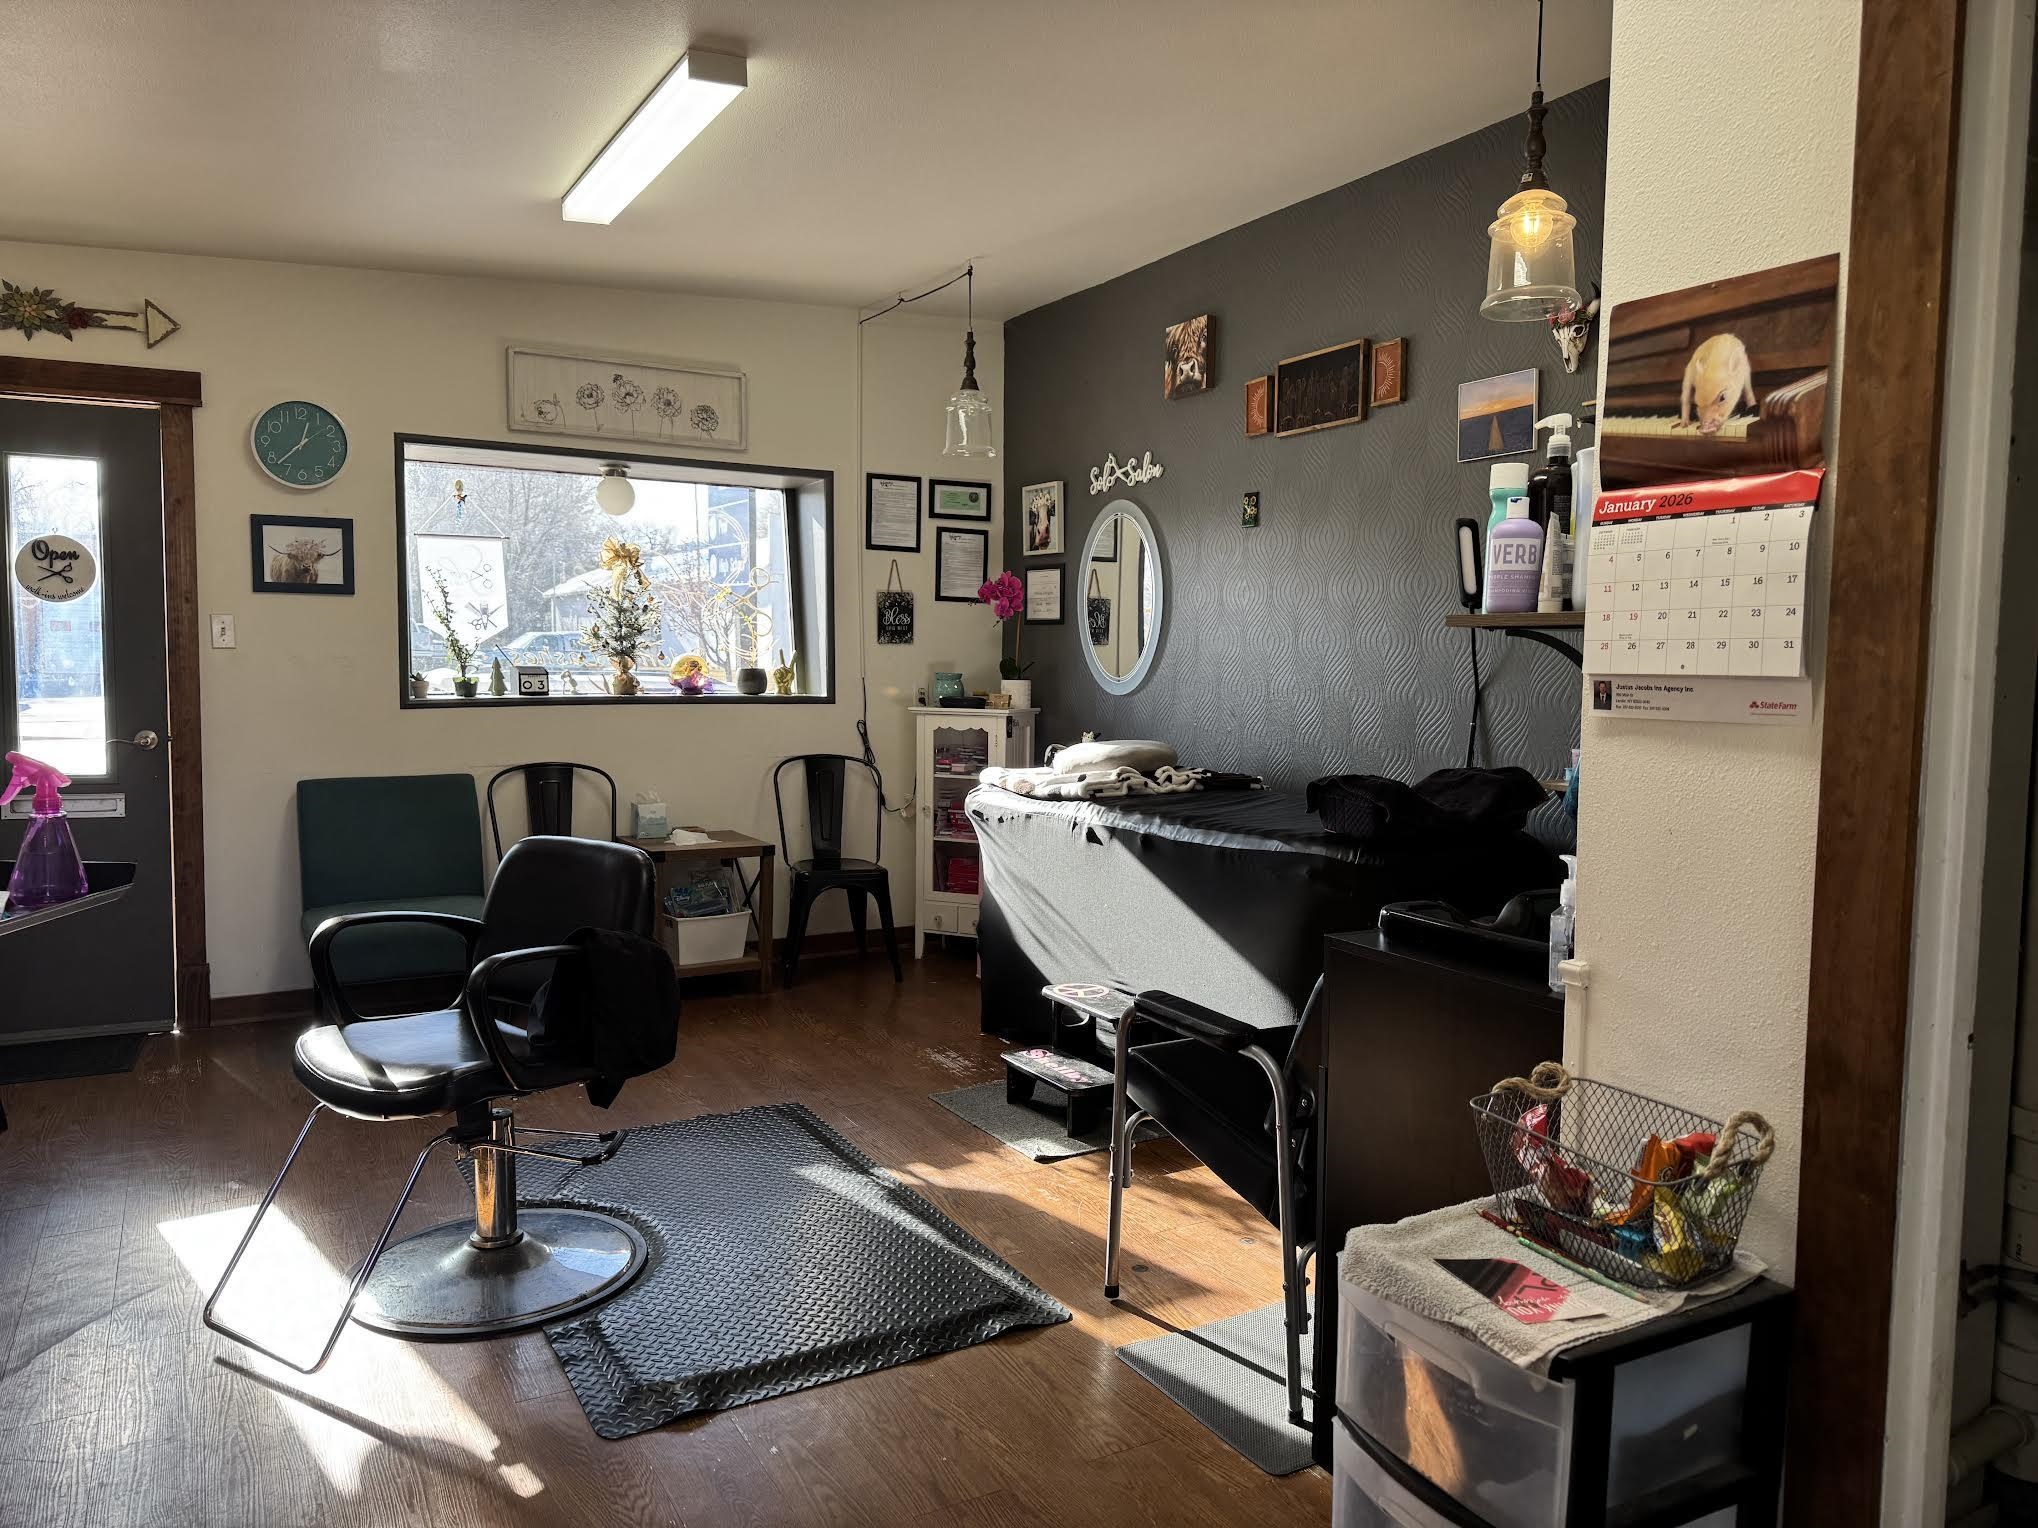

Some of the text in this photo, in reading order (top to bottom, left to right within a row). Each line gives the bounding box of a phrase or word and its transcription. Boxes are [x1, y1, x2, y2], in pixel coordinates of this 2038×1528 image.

[280, 410, 289, 423] 11
[294, 406, 307, 420] 12
[316, 412, 320, 425] 1
[267, 421, 282, 433] 10
[326, 425, 336, 438] 2
[260, 435, 270, 447] 9
[332, 440, 341, 452] 3
[268, 451, 276, 464] 8
[327, 455, 335, 468] 4
[283, 463, 292, 476] 7
[297, 469, 307, 480] 6
[314, 466, 324, 478] 5
[1090, 451, 1163, 495] Solo Salon
[1599, 493, 1694, 514] January 2026
[1730, 516, 1735, 524] 1
[1764, 513, 1770, 521] 2
[1789, 542, 1800, 550] 10
[32, 540, 80, 568] Open
[1493, 544, 1537, 564] VERB
[1689, 580, 1698, 588] 14
[1753, 577, 1763, 585] 16
[1787, 575, 1798, 583] 17
[26, 585, 84, 599] walk-ins welcome
[882, 606, 911, 625] Bless
[1658, 612, 1667, 620] 20
[1688, 611, 1696, 619] 21
[1719, 610, 1728, 618] 22
[1786, 608, 1796, 616] 24
[1628, 642, 1636, 650] 26
[1749, 641, 1759, 649] 30
[1664, 685, 1683, 693] Agency
